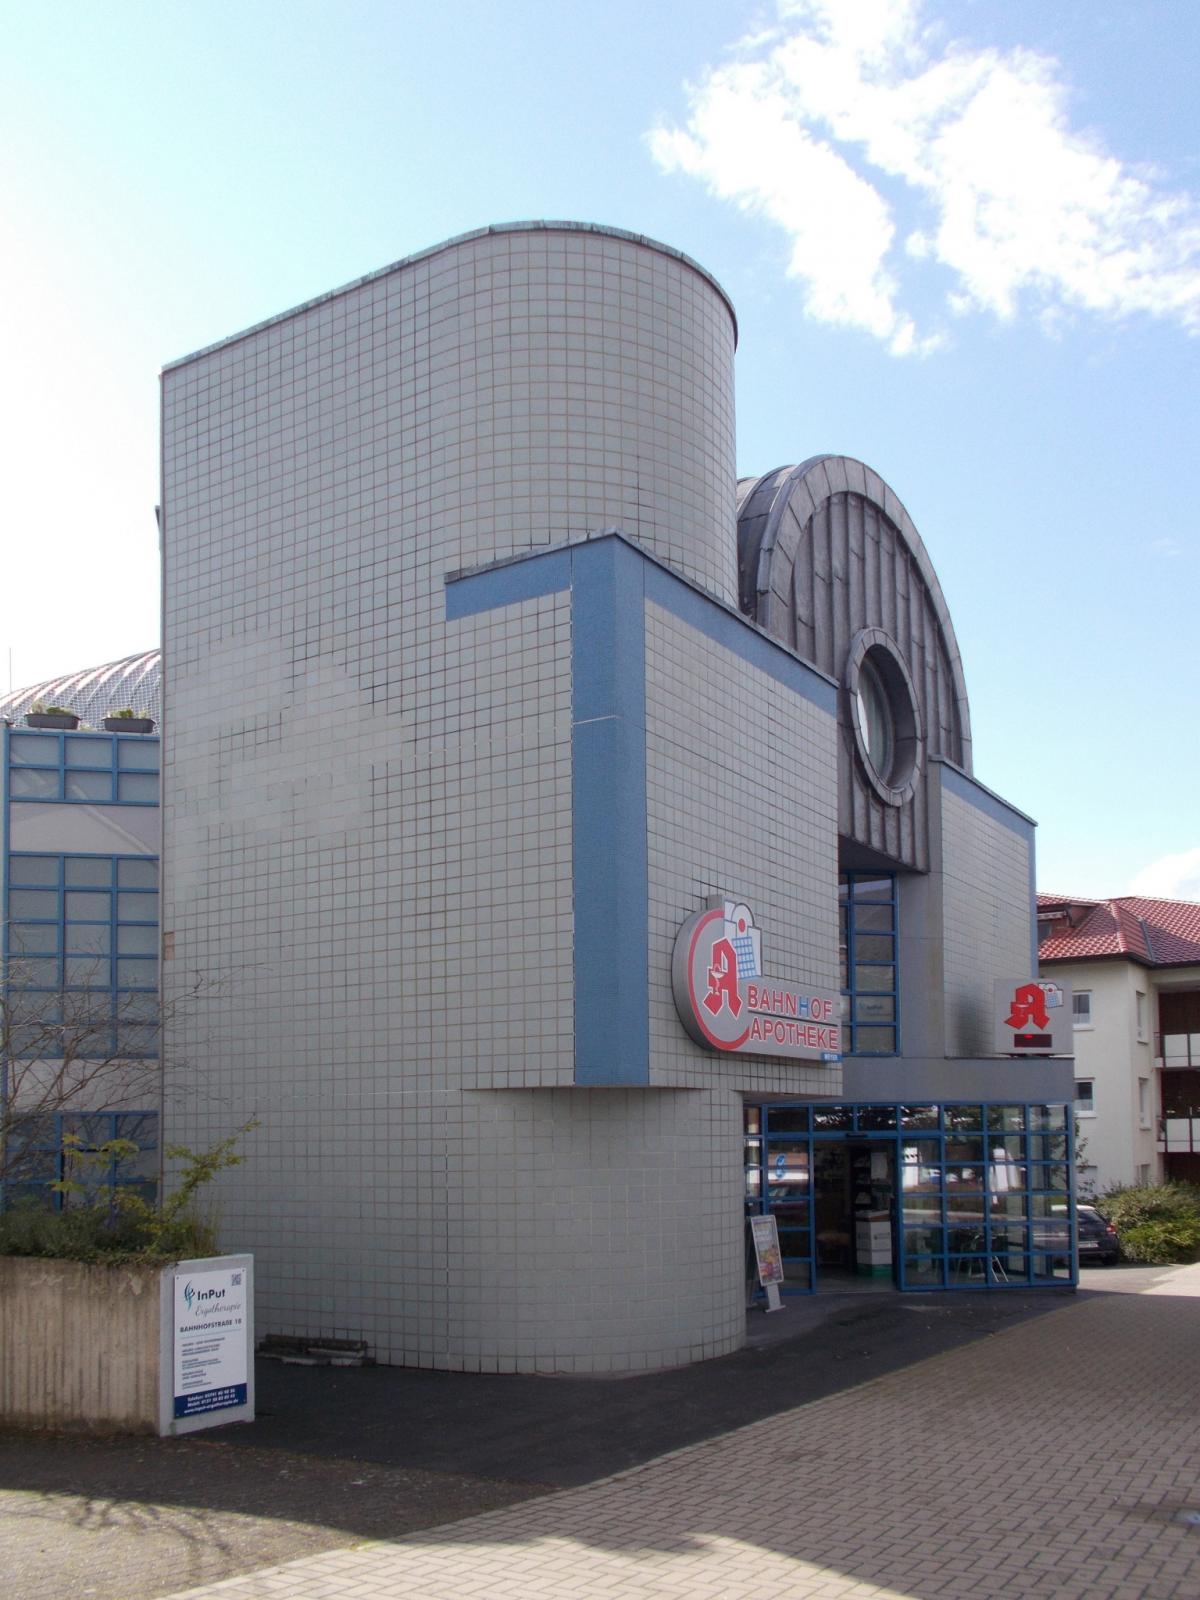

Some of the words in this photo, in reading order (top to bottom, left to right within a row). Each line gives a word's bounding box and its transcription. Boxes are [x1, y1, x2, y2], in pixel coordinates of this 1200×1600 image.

[747, 984, 833, 1021] BAHNHOF
[749, 1016, 839, 1051] APOTHEKE
[197, 1289, 225, 1301] InPut
[195, 1302, 241, 1318] Ergotherapie
